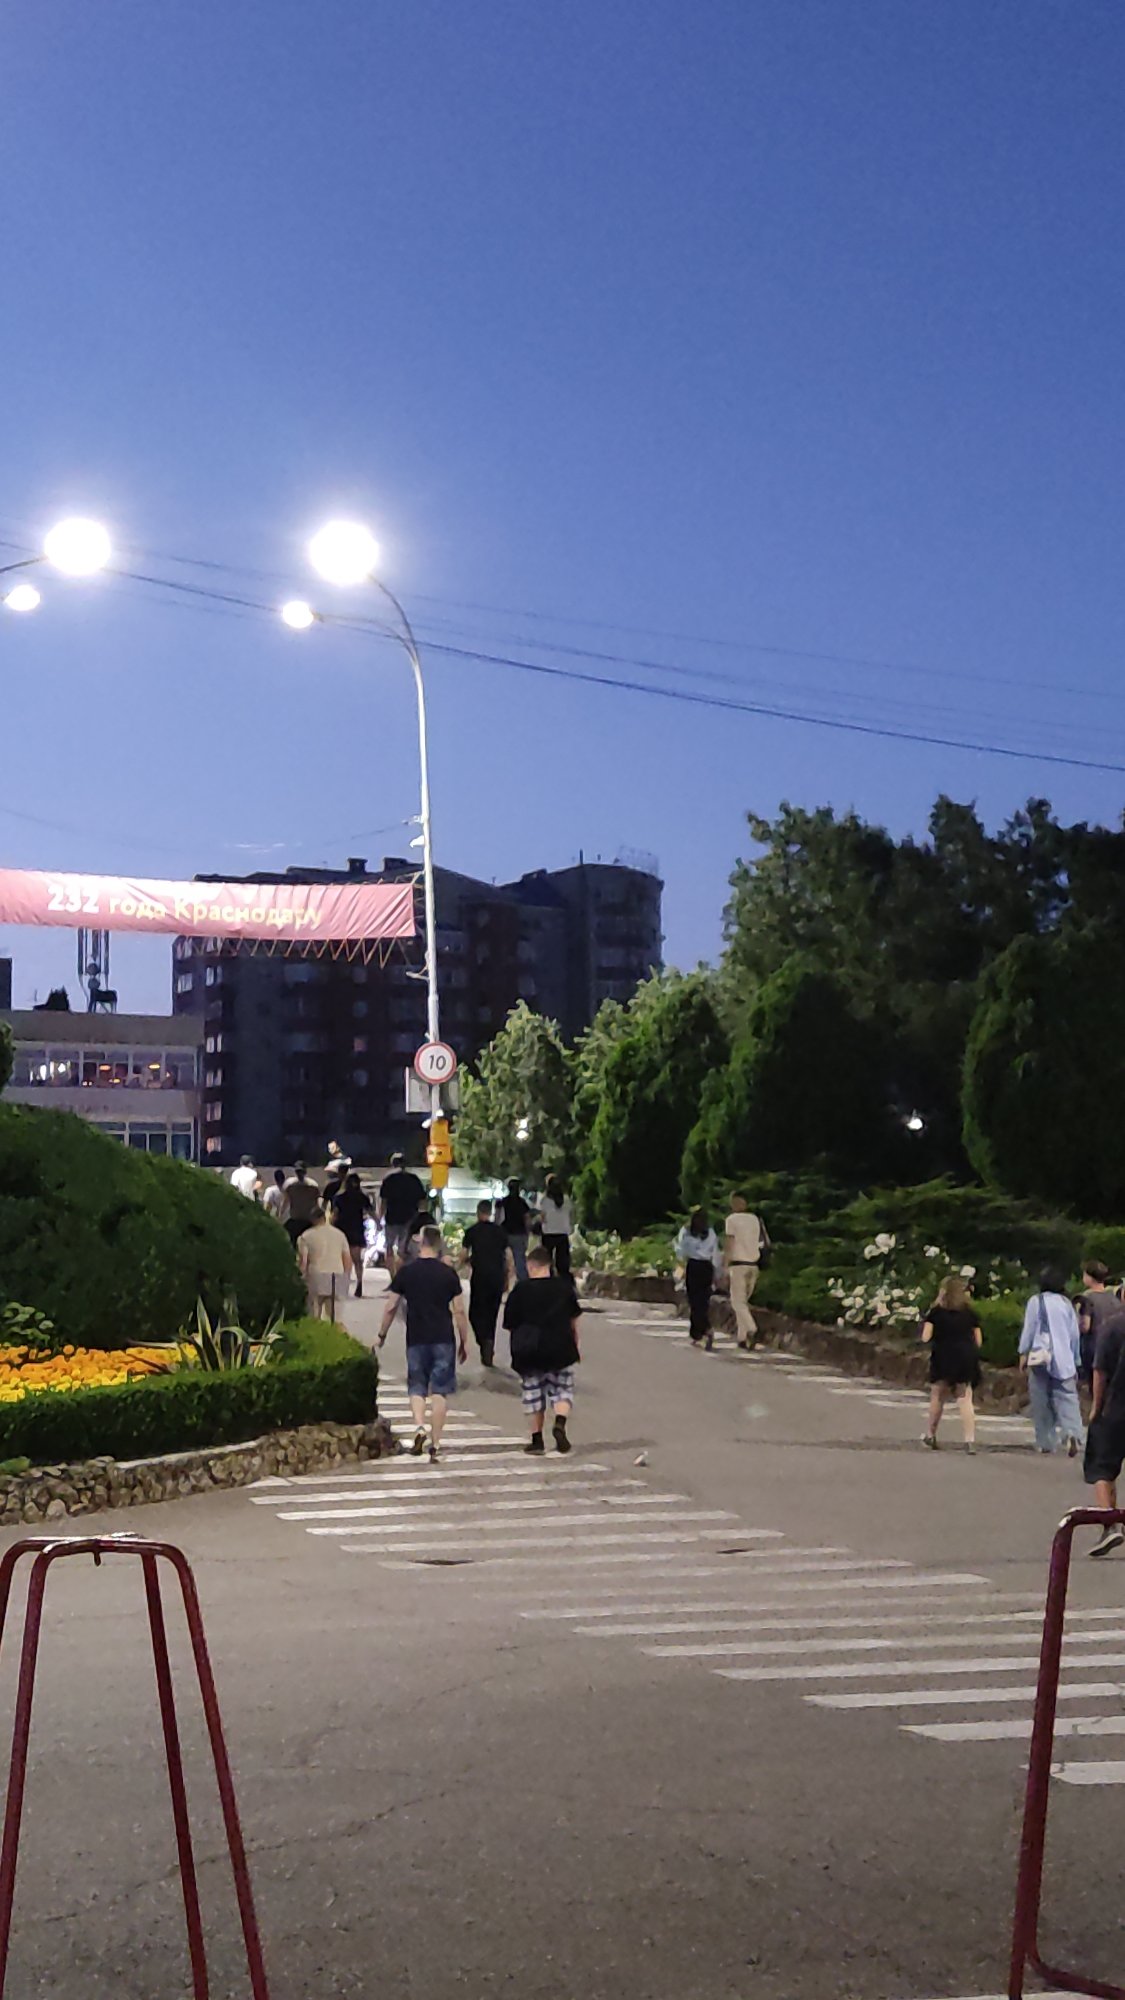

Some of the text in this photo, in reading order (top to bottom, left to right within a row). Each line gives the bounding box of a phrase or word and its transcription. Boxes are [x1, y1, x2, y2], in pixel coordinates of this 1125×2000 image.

[47, 884, 322, 930] 232 года Краснодару
[428, 1054, 447, 1071] 10
